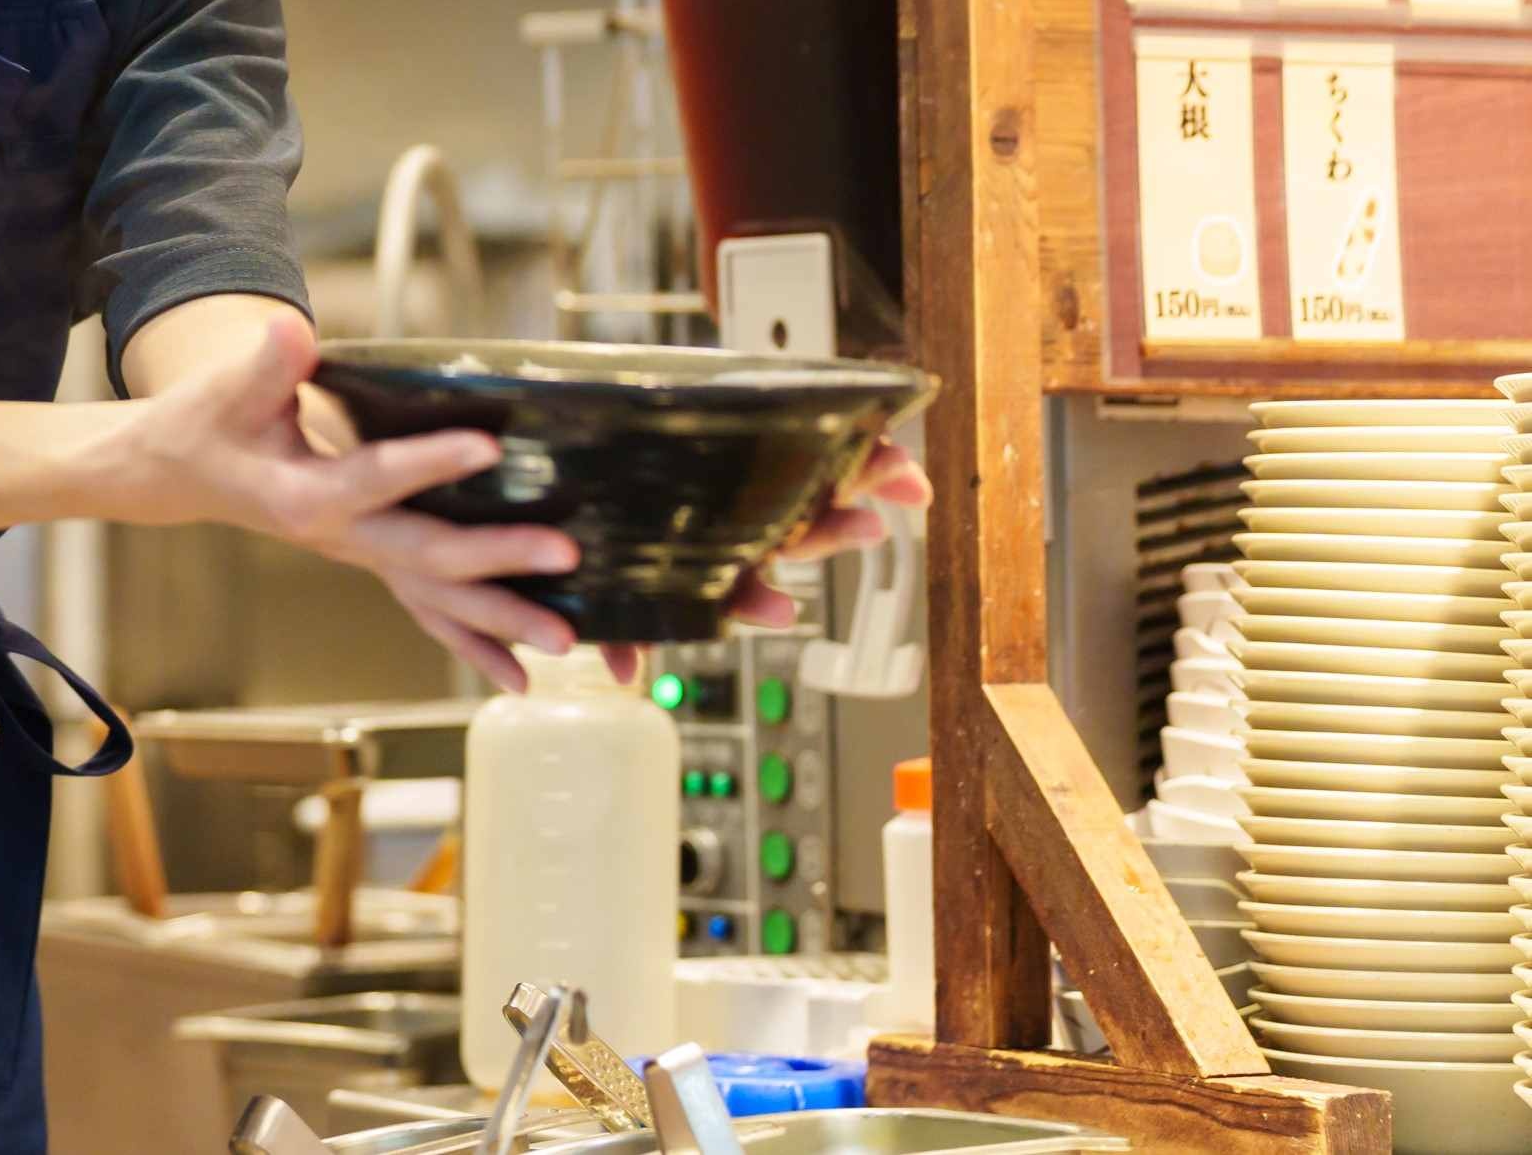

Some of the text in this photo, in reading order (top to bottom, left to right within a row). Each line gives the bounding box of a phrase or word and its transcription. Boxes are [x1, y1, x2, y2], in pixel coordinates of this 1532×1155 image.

[1176, 60, 1211, 142] 大根
[1325, 70, 1354, 184] ちくわ
